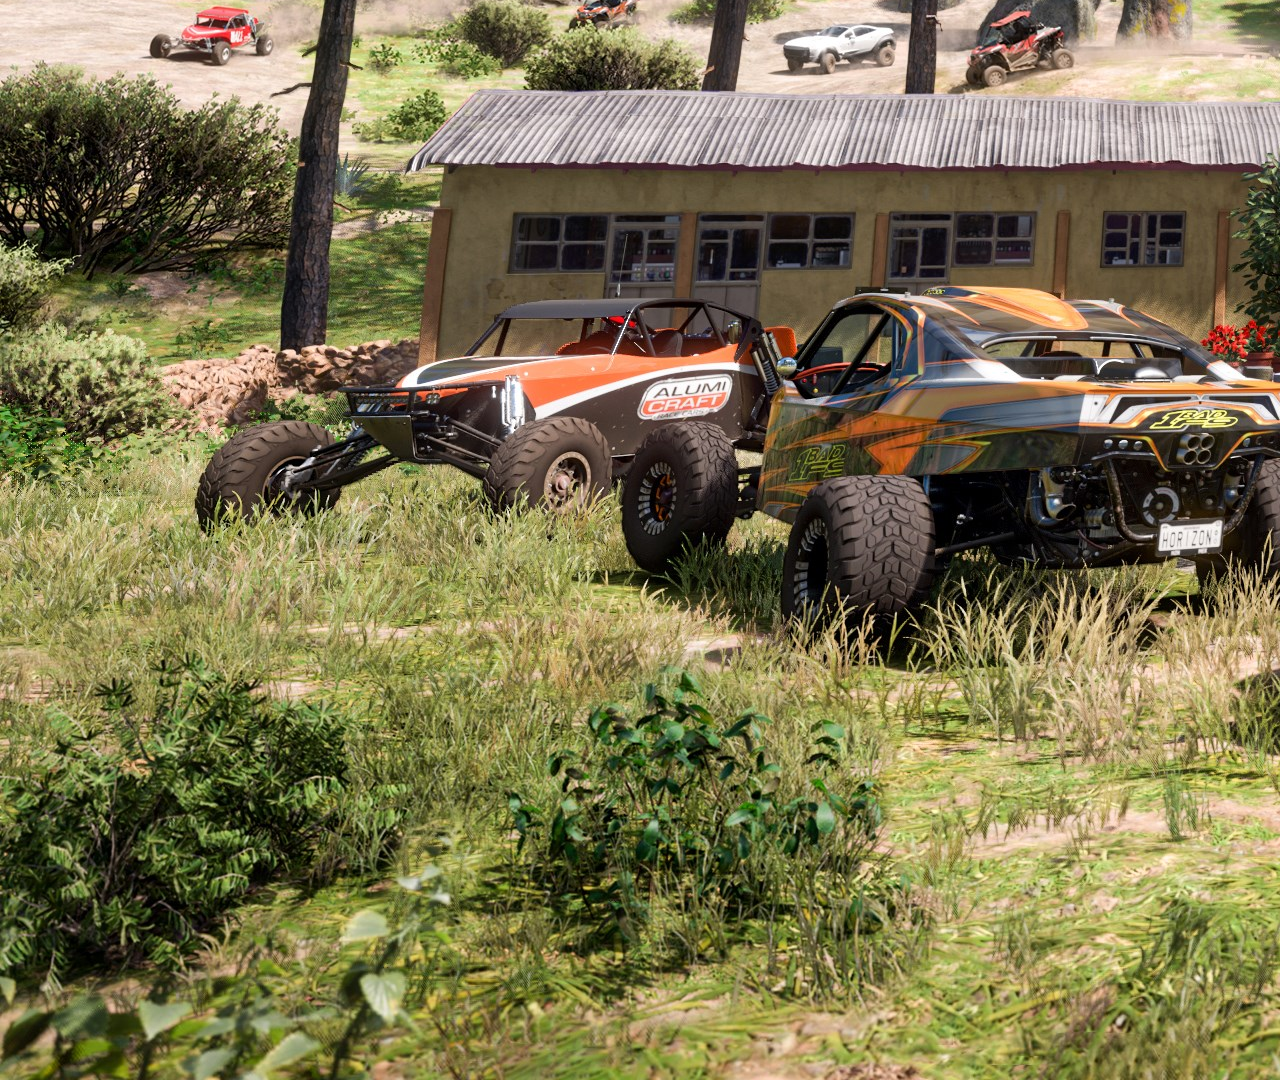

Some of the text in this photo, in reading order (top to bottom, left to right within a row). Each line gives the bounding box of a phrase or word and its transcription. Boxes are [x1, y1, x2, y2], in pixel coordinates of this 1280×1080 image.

[654, 381, 727, 398] ALUMI
[647, 394, 723, 413] CRAFT
[1161, 529, 1213, 549] HORIZON
